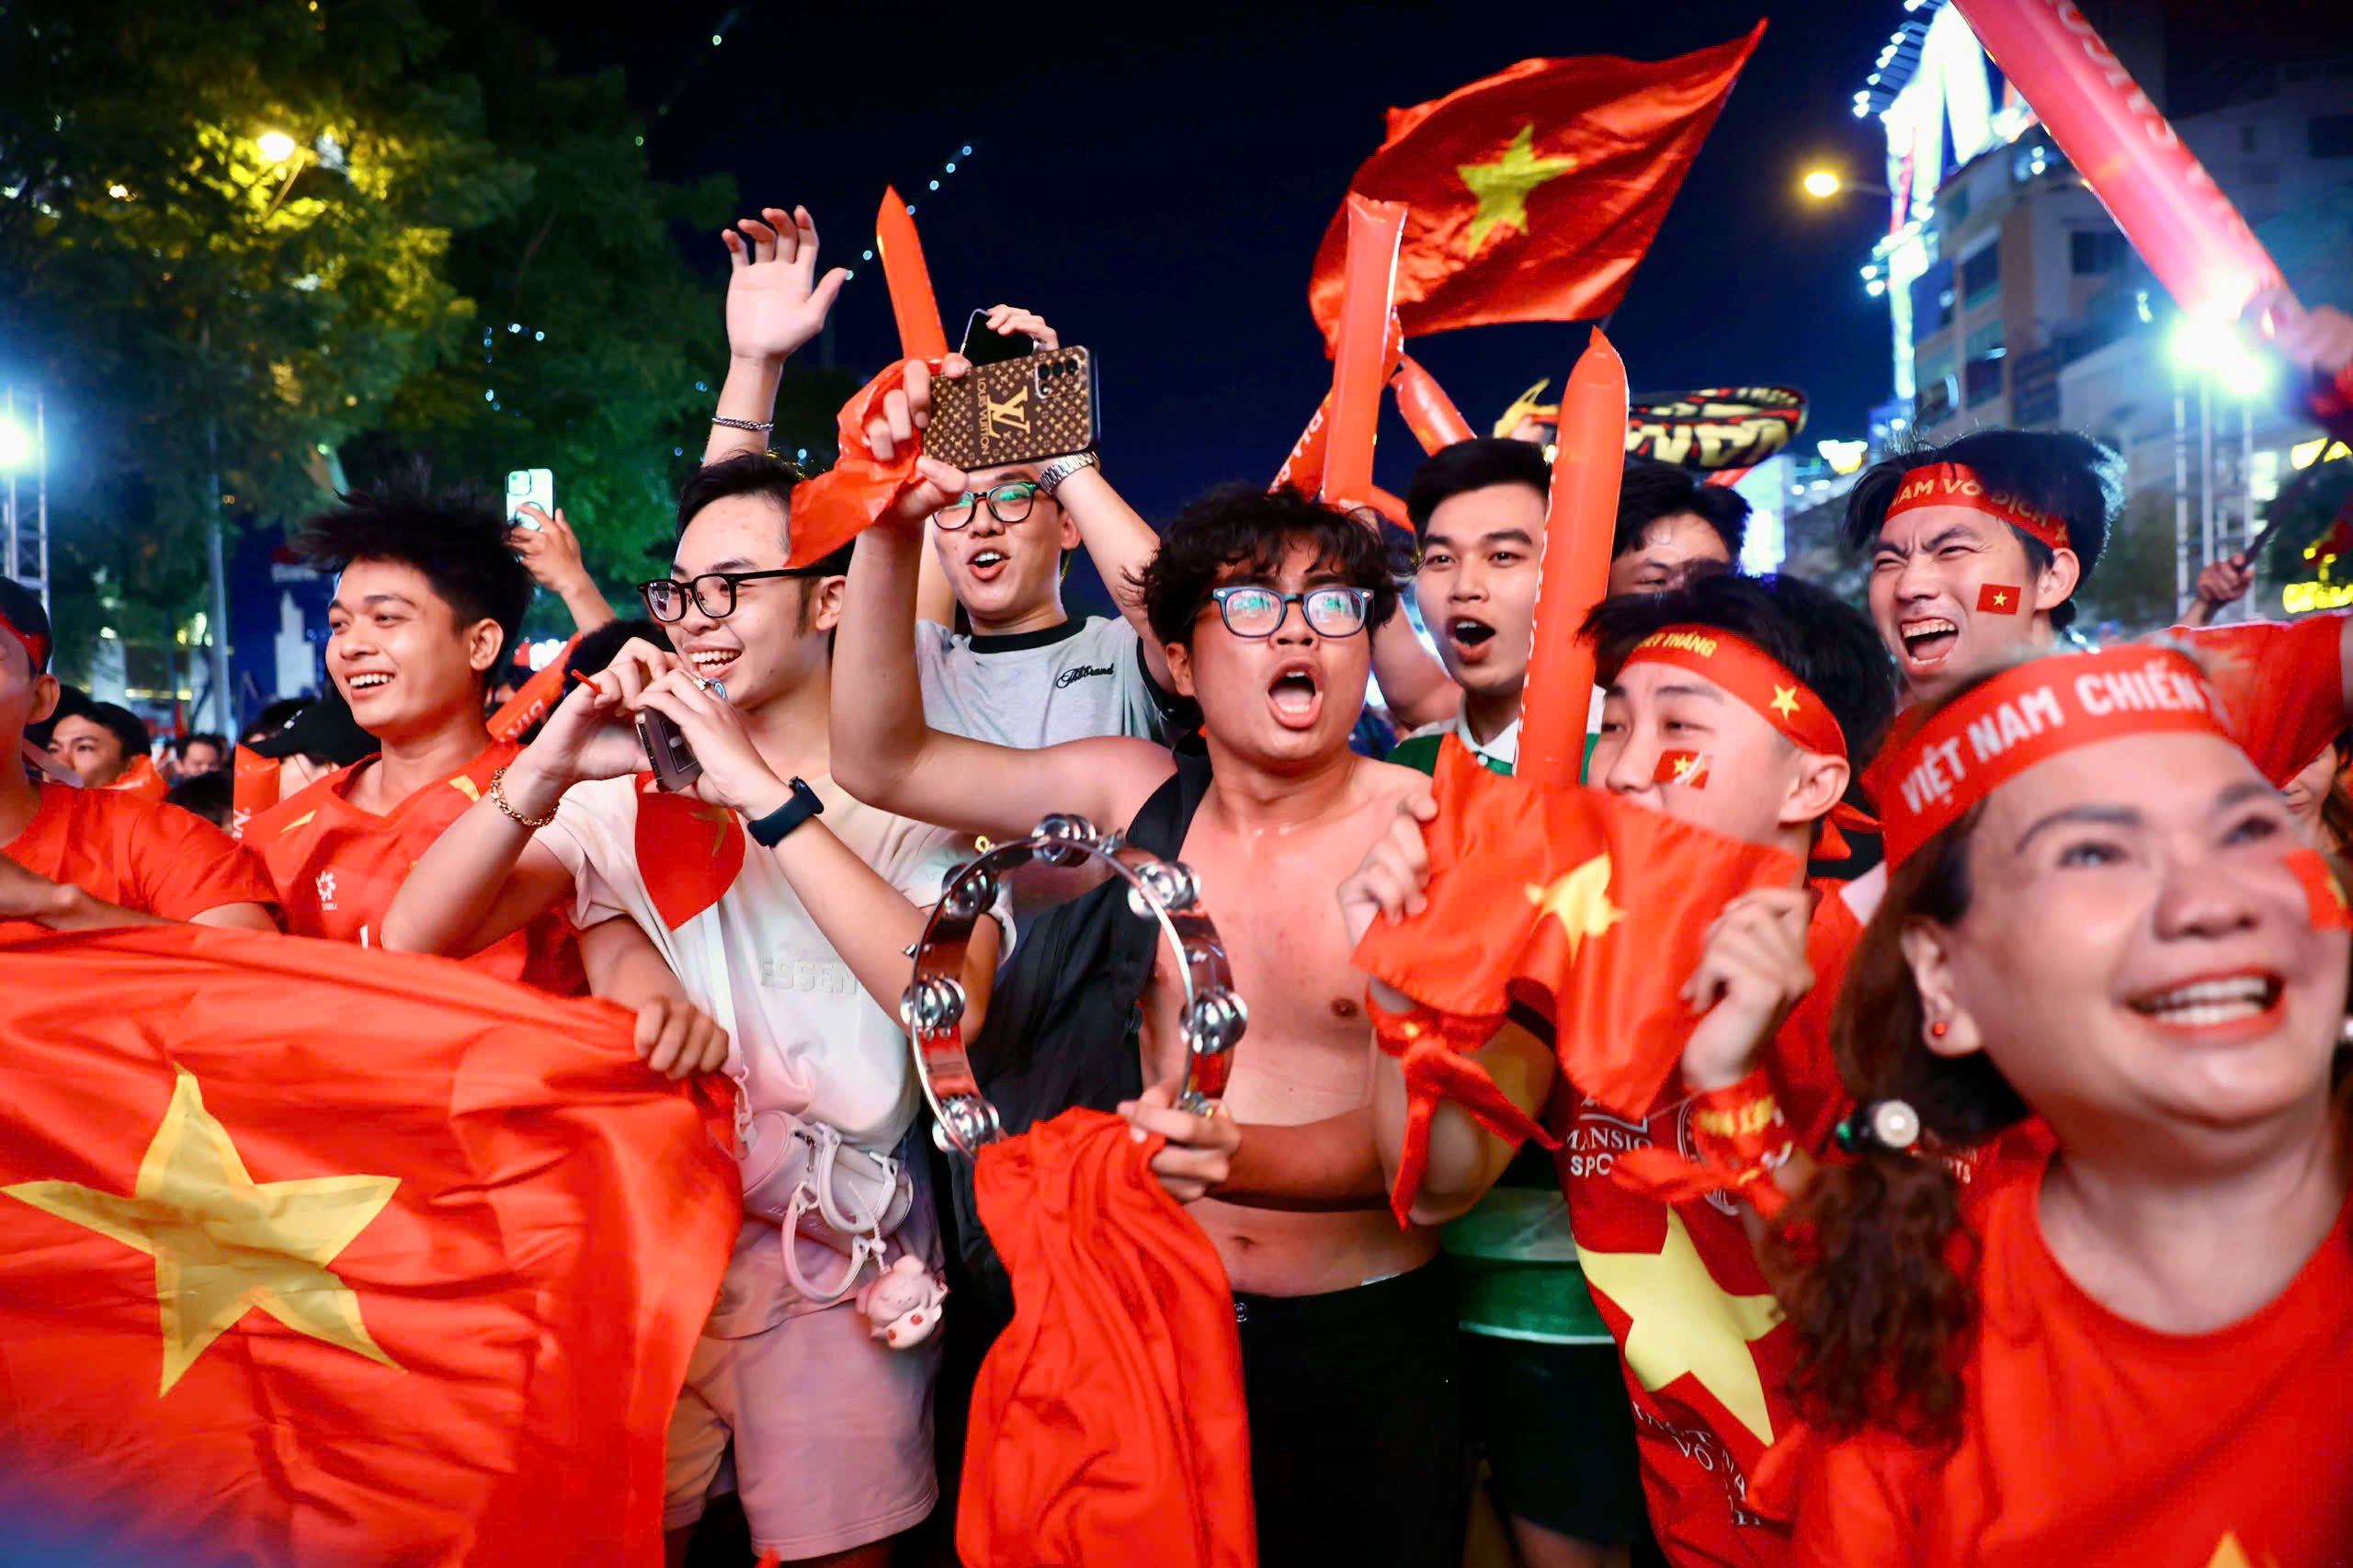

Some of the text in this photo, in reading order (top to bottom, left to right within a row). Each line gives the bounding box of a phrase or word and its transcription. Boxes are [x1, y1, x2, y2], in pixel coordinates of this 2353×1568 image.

[977, 378, 991, 455] LOUIS VUITTON
[1892, 479, 1935, 506] AM
[1967, 686, 2064, 763] NAM
[760, 956, 857, 994] ESSEN
[1567, 1127, 1654, 1151] MANSIO
